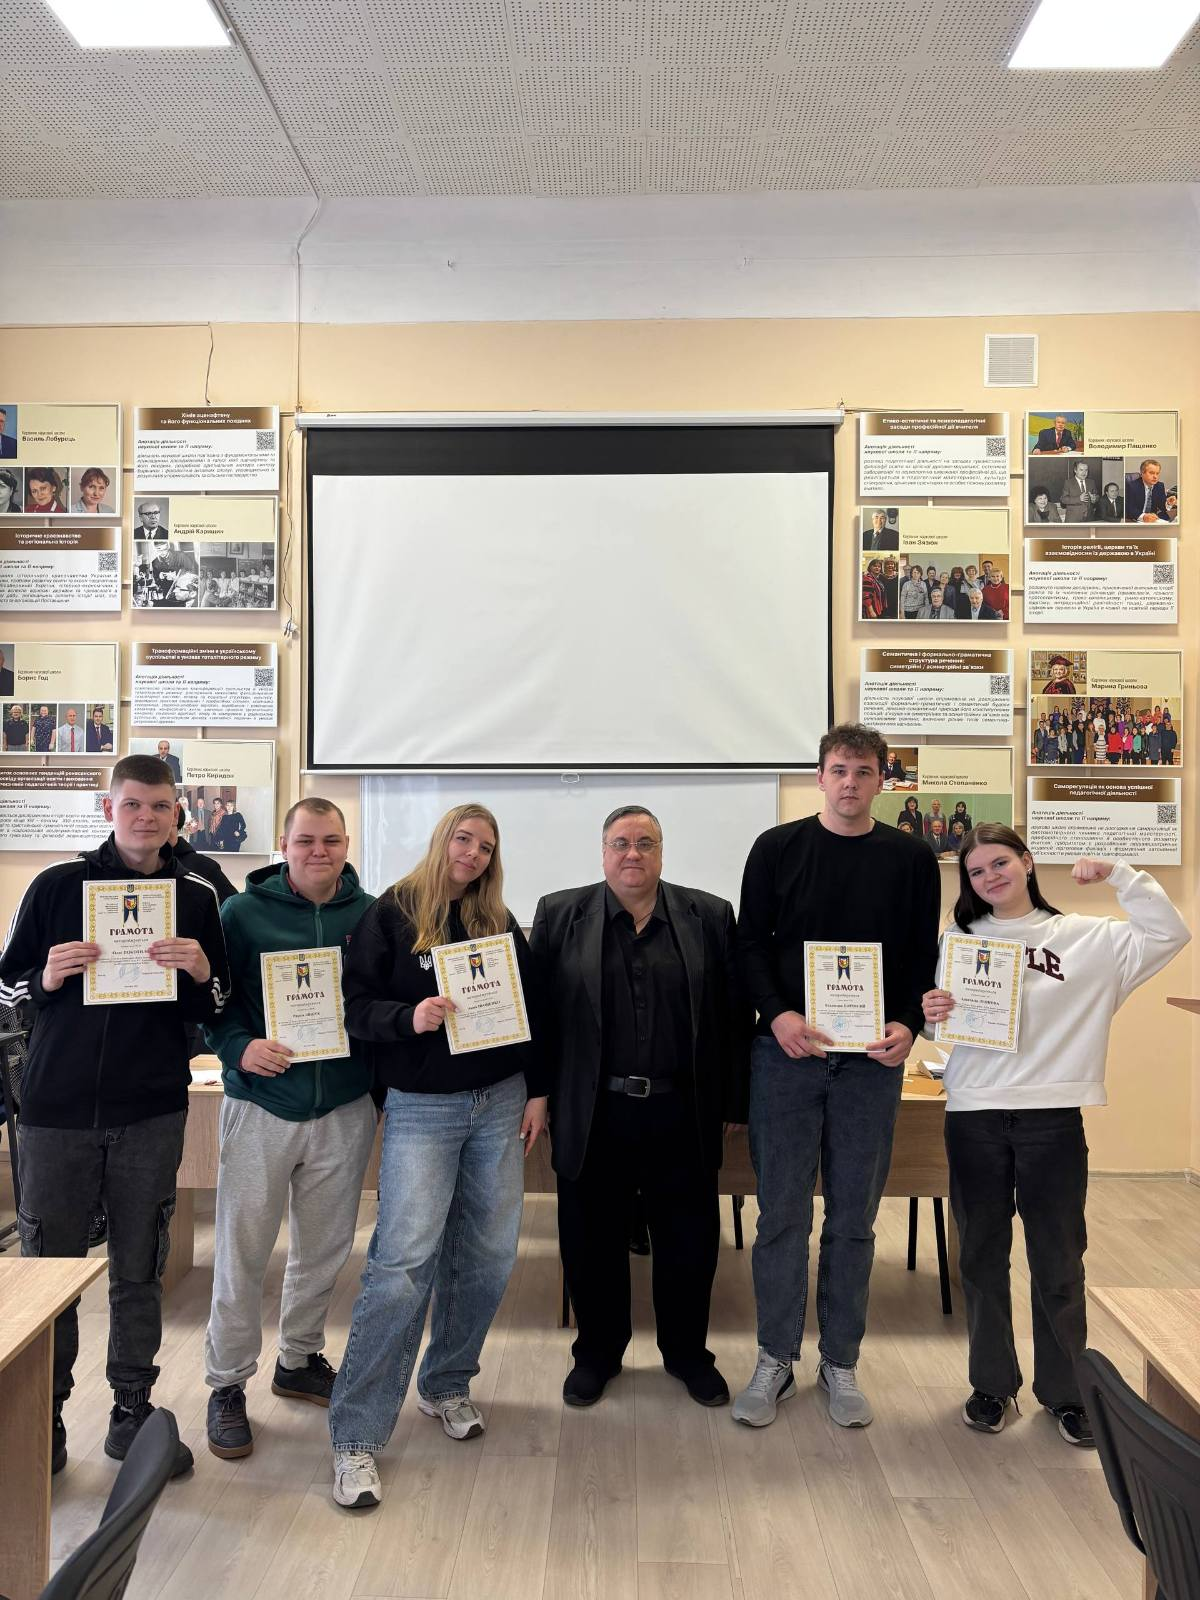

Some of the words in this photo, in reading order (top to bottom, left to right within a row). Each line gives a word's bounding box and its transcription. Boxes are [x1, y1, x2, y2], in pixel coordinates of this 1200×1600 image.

[110, 928, 154, 936] ГРАМОТА
[1025, 946, 1065, 982] LE
[462, 980, 501, 994] ГРАМОТА
[826, 984, 864, 992] ГРАМОТА
[962, 977, 1002, 989] ГРАМОТА
[286, 991, 325, 1001] ГРАМОТА
